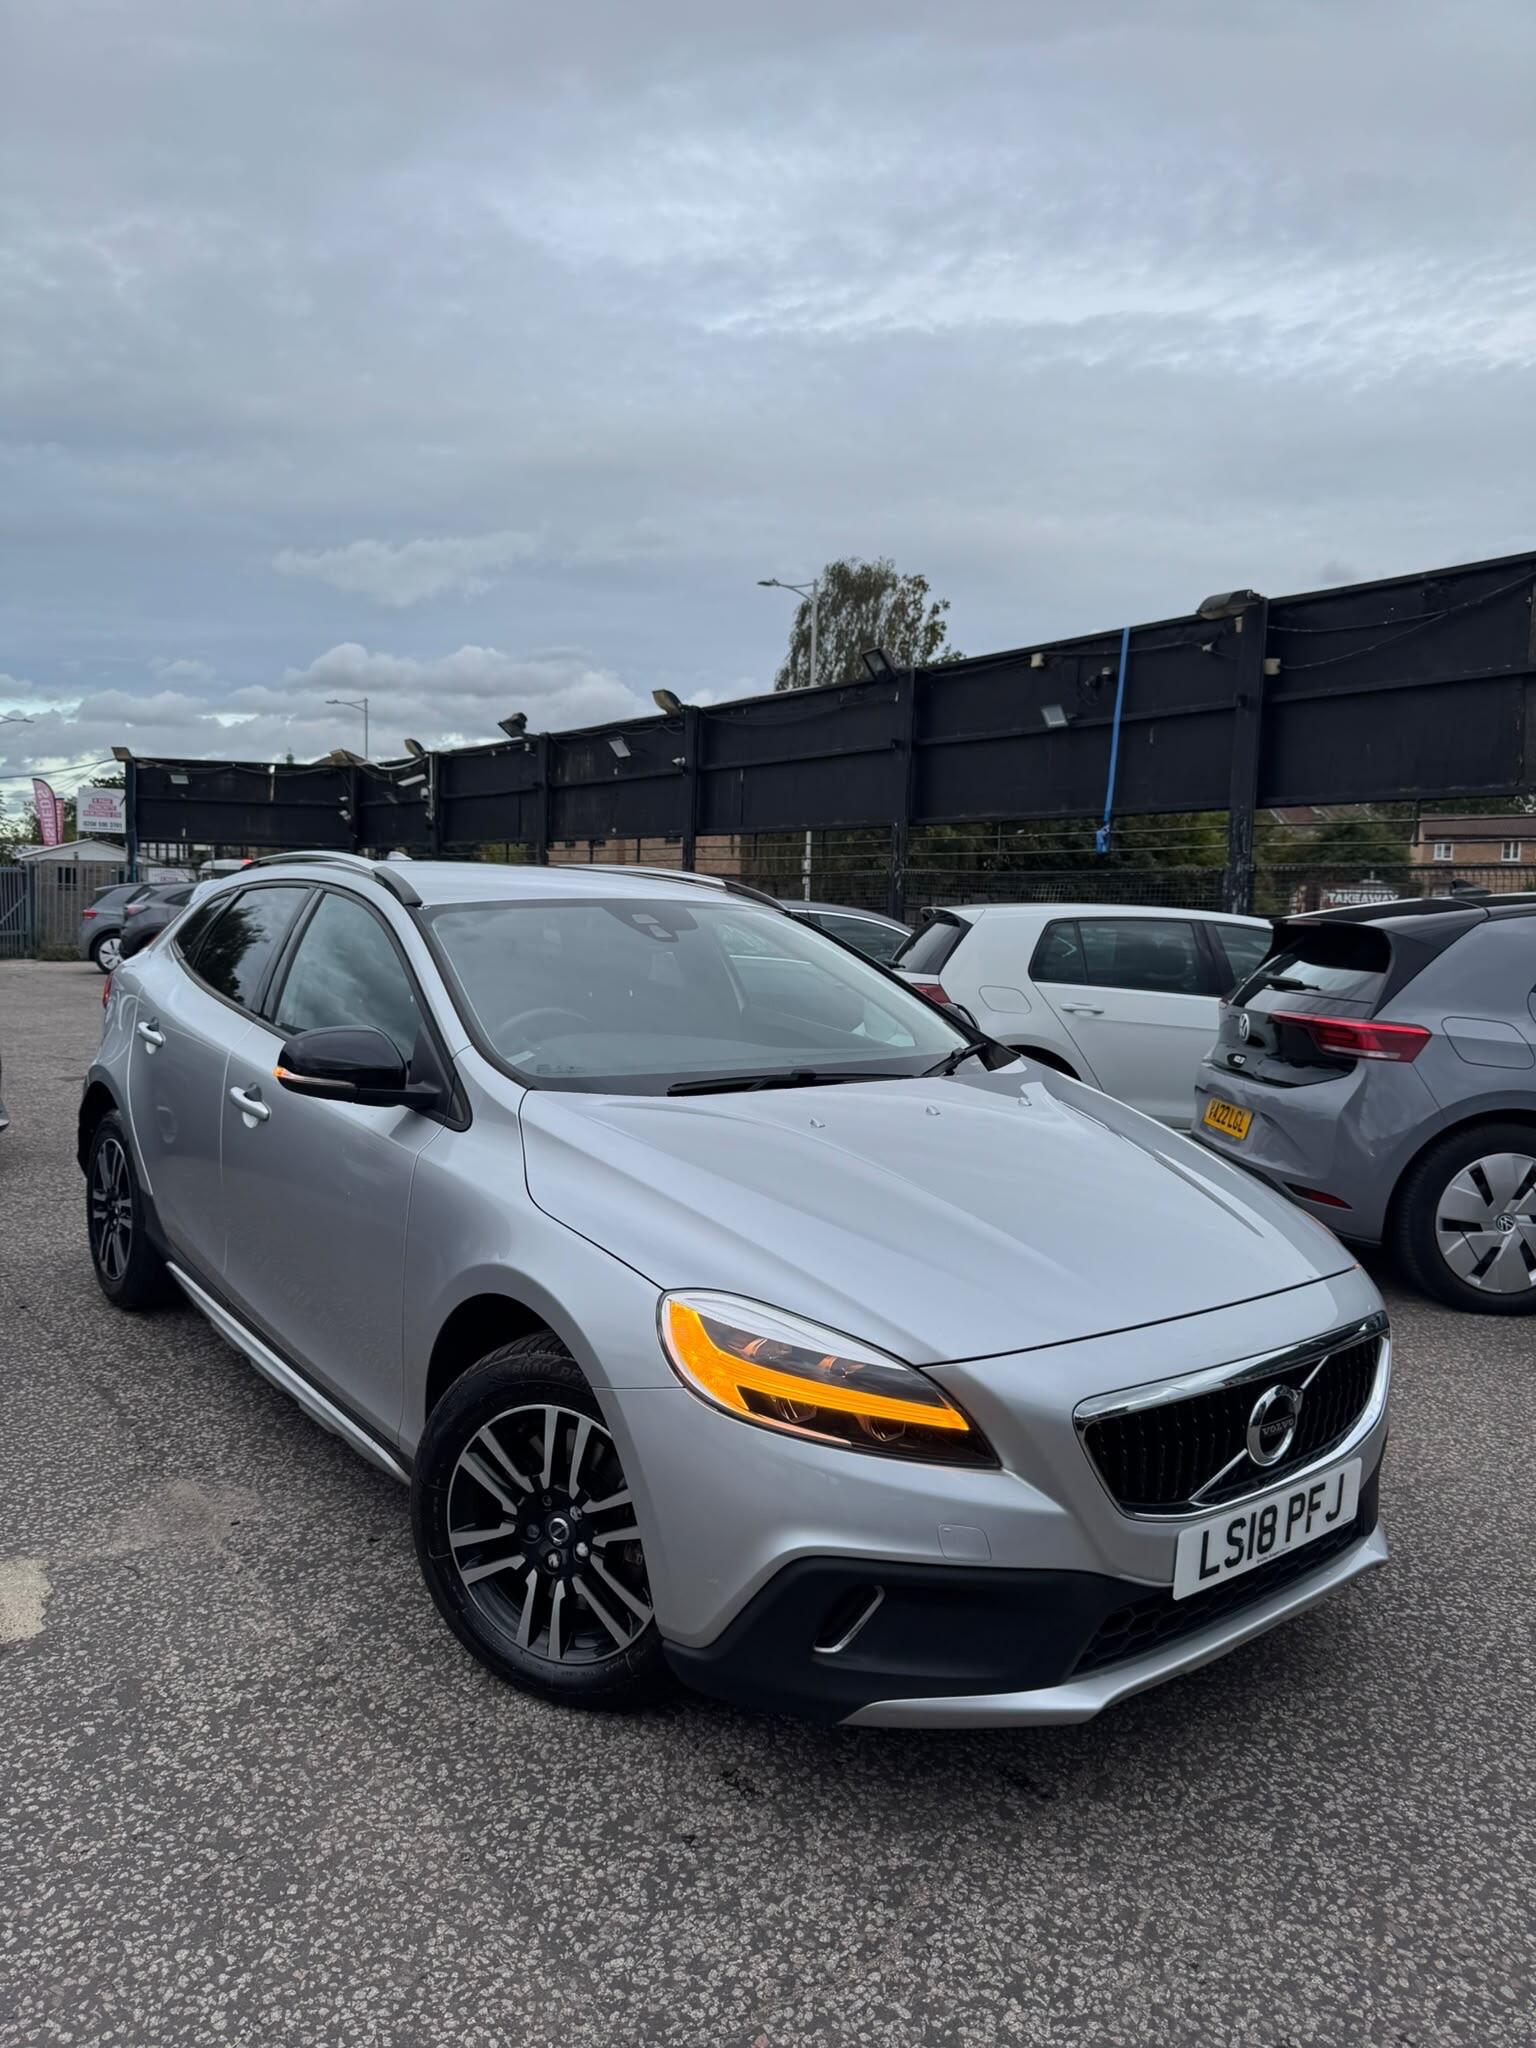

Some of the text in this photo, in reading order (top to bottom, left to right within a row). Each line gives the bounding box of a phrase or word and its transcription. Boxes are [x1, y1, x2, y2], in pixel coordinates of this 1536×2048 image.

[1327, 892, 1399, 904] TAKEAWAY
[1262, 1418, 1294, 1435] VOLVO
[1199, 1472, 1345, 1580] LS18 PFJ
